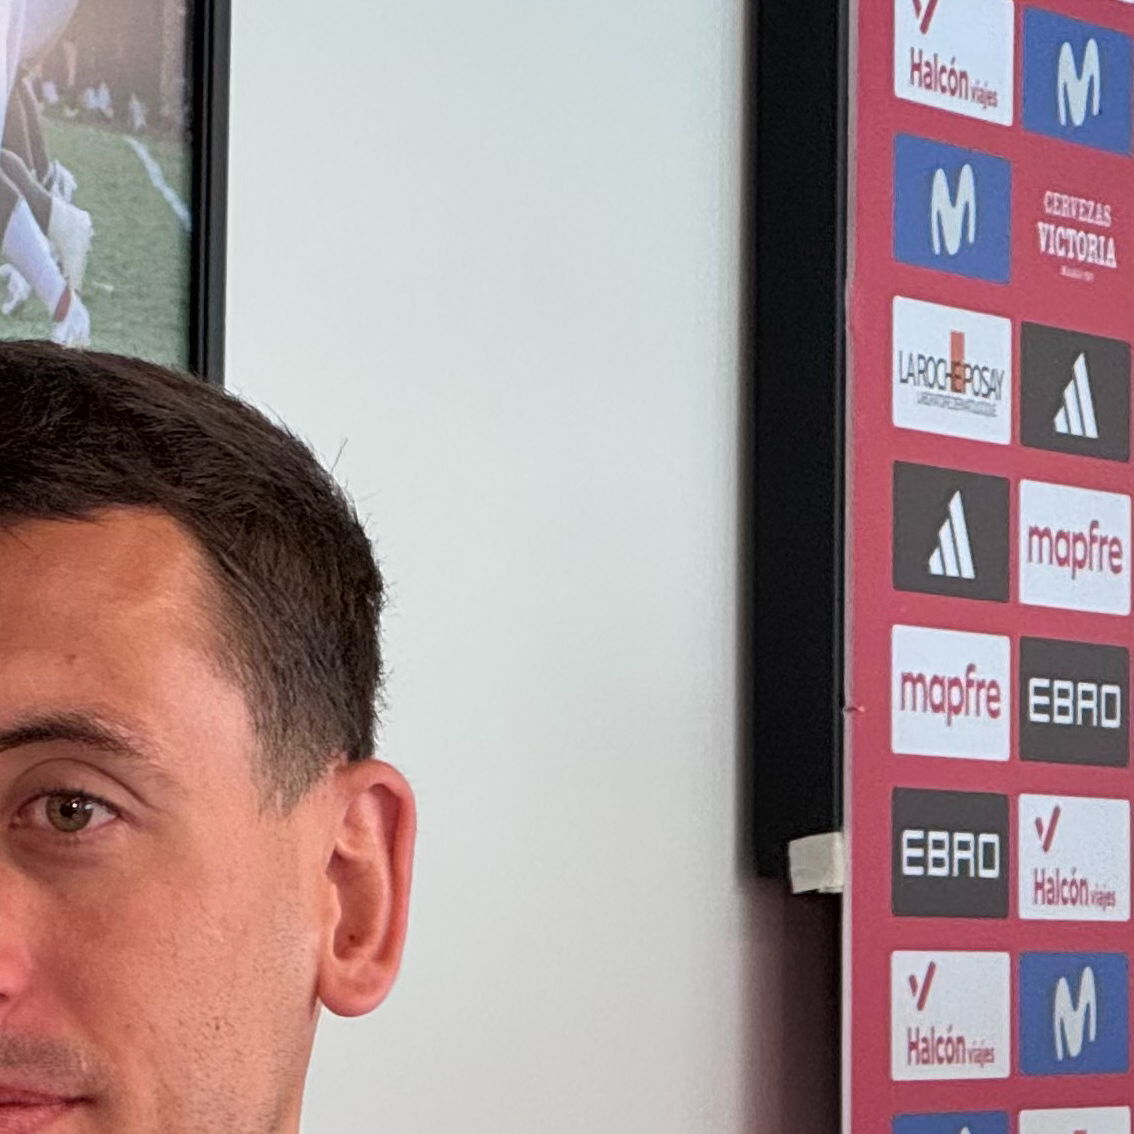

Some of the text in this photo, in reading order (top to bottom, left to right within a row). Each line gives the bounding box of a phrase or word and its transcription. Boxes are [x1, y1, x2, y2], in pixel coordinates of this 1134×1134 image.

[910, 47, 998, 110] Halcón viajes
[1043, 190, 1112, 227] CERVEZAS
[1037, 221, 1118, 268] VICTORIA
[1028, 519, 1123, 580] mapfre
[900, 663, 1002, 727] mapfre
[1033, 867, 1116, 912] Halcón viajes
[907, 1025, 995, 1067] Halcón viajes
